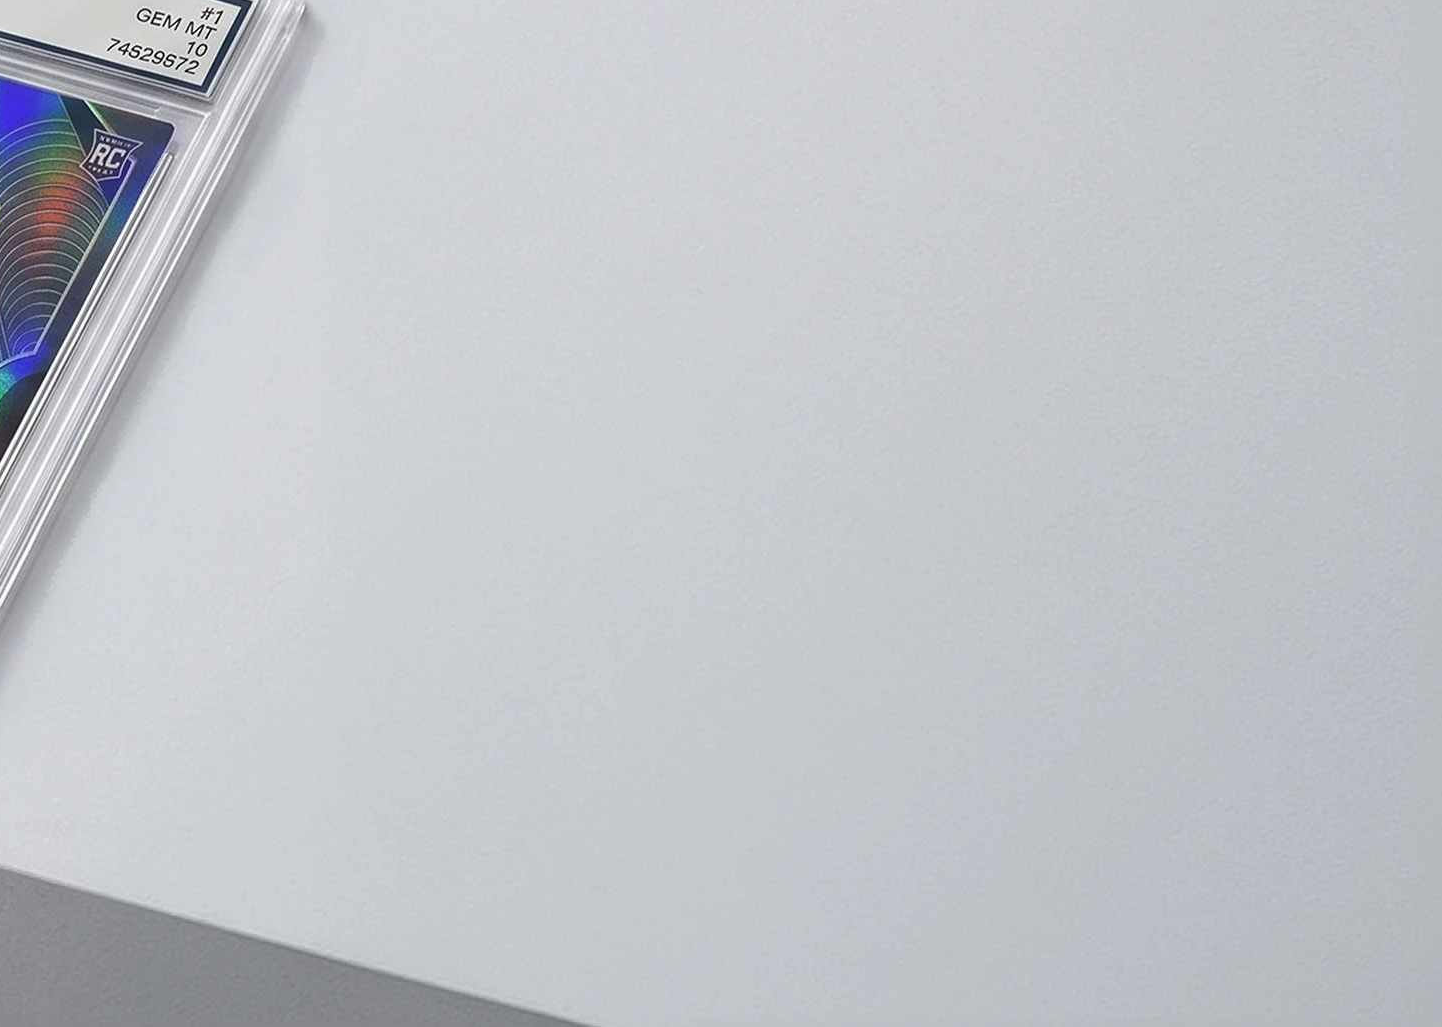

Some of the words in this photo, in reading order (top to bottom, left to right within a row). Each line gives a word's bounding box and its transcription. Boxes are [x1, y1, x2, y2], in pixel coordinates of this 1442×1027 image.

[136, 7, 182, 31] GEM
[184, 21, 218, 40] MT
[200, 7, 224, 25] #1
[187, 41, 208, 57] 10
[88, 142, 127, 169] RC
